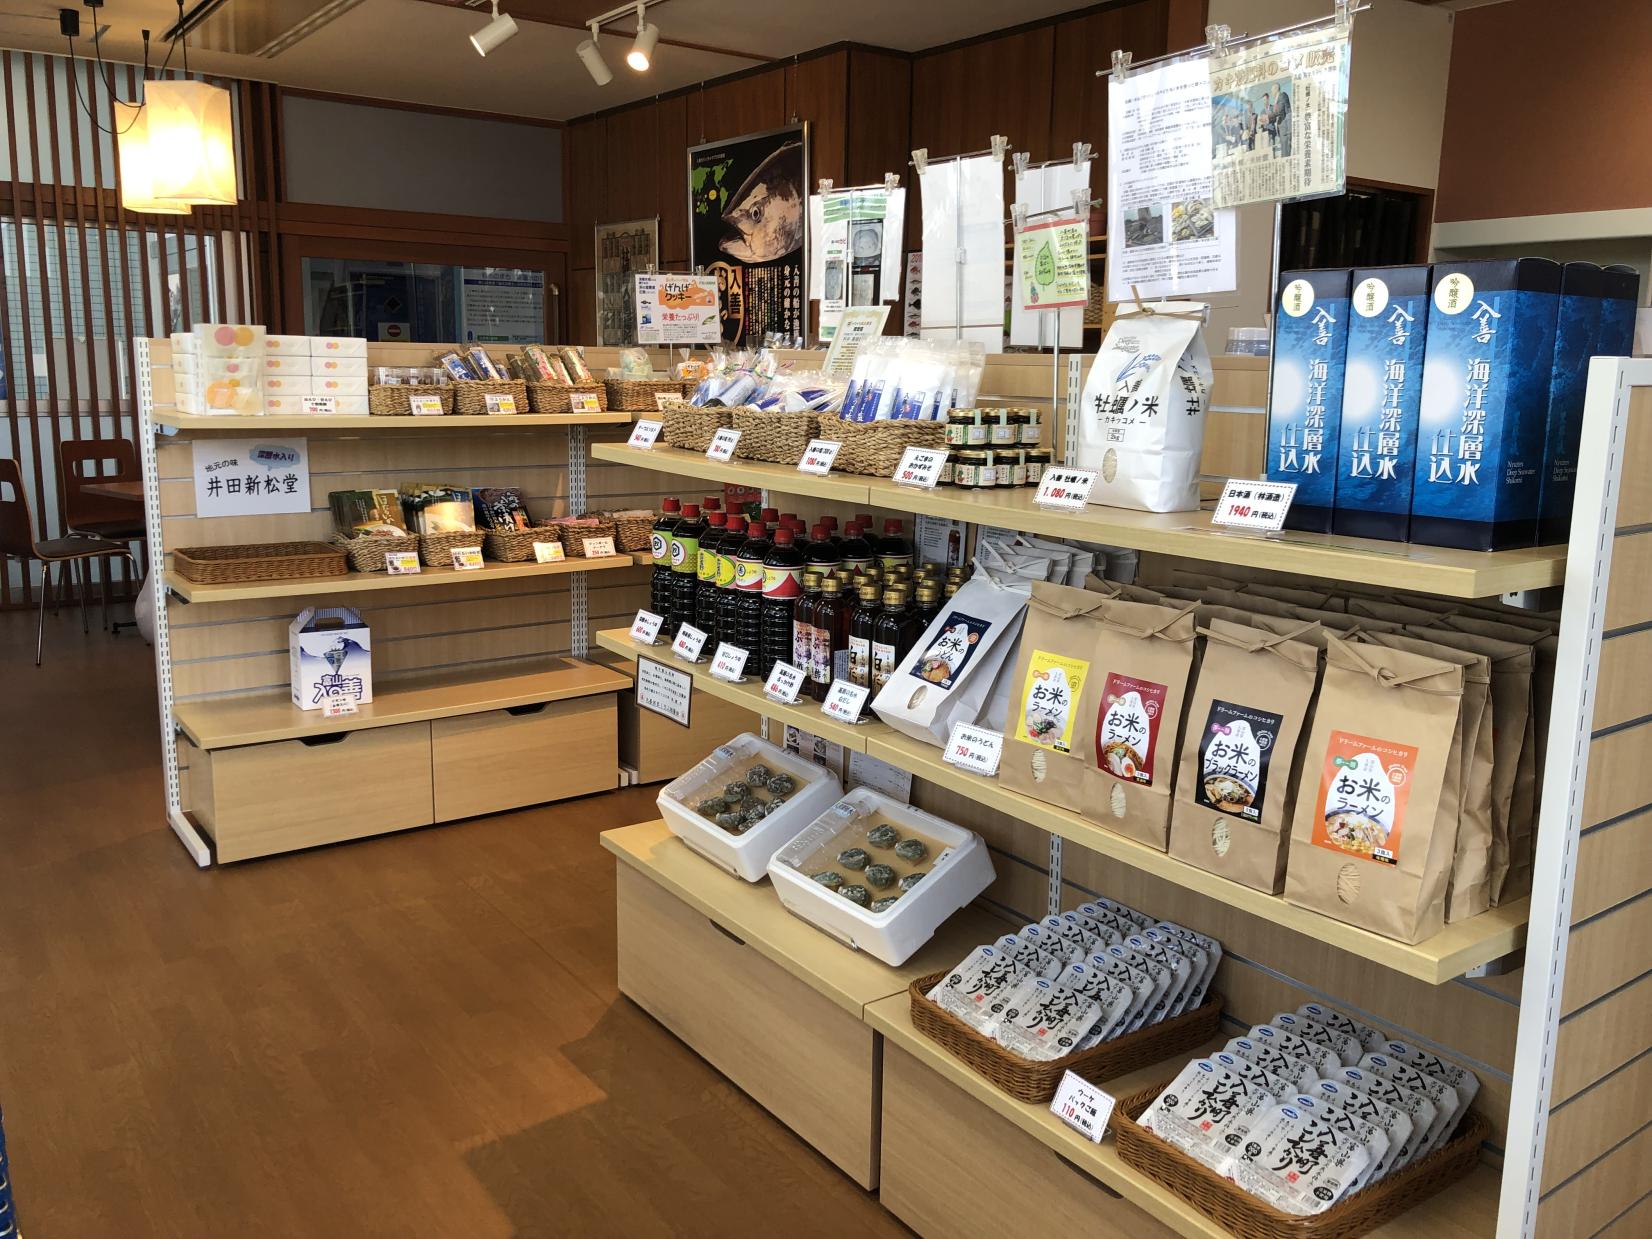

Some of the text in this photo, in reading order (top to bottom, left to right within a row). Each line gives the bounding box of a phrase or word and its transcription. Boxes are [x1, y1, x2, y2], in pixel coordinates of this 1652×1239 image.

[664, 283, 690, 293] げんげ
[664, 292, 692, 302] クッキー
[730, 268, 742, 315] 入善
[1311, 306, 1337, 346] 入善
[1386, 304, 1415, 346] 入善
[1470, 300, 1502, 344] 入善
[1118, 379, 1143, 393] 入善
[1094, 392, 1160, 418] 牡蠣ノ米
[1303, 358, 1329, 474] 海洋深層水
[1375, 359, 1406, 480] 海洋深層水
[1455, 357, 1491, 486] 海洋深層水
[1278, 422, 1302, 474] 仕込
[1350, 424, 1377, 480] 仕込
[1427, 428, 1457, 484] 仕込
[205, 459, 239, 472] 地元の味
[901, 471, 913, 481] 500
[206, 473, 299, 498] 井田新松堂
[1064, 492, 1085, 501] 円(税込)
[1228, 504, 1277, 521] 1940 円(税込)
[937, 636, 965, 654] お米の
[1032, 684, 1069, 707] お米の
[1031, 701, 1063, 718] ラーメン
[1216, 706, 1276, 725] ドリームファームのコシヒカリ
[1107, 710, 1147, 735] お米の
[960, 733, 994, 749] お米のうどん
[1107, 728, 1142, 747] ラーメン
[1339, 737, 1409, 758] ドリームファームのコシヒカリ
[955, 745, 969, 757] 750
[1211, 740, 1257, 767] お米の
[1205, 757, 1258, 783] ブラックラーメン
[1336, 774, 1391, 804] お米の
[1336, 796, 1384, 818] ラーメン
[1078, 1089, 1095, 1103] ウーケ
[1062, 1103, 1075, 1117] 110
